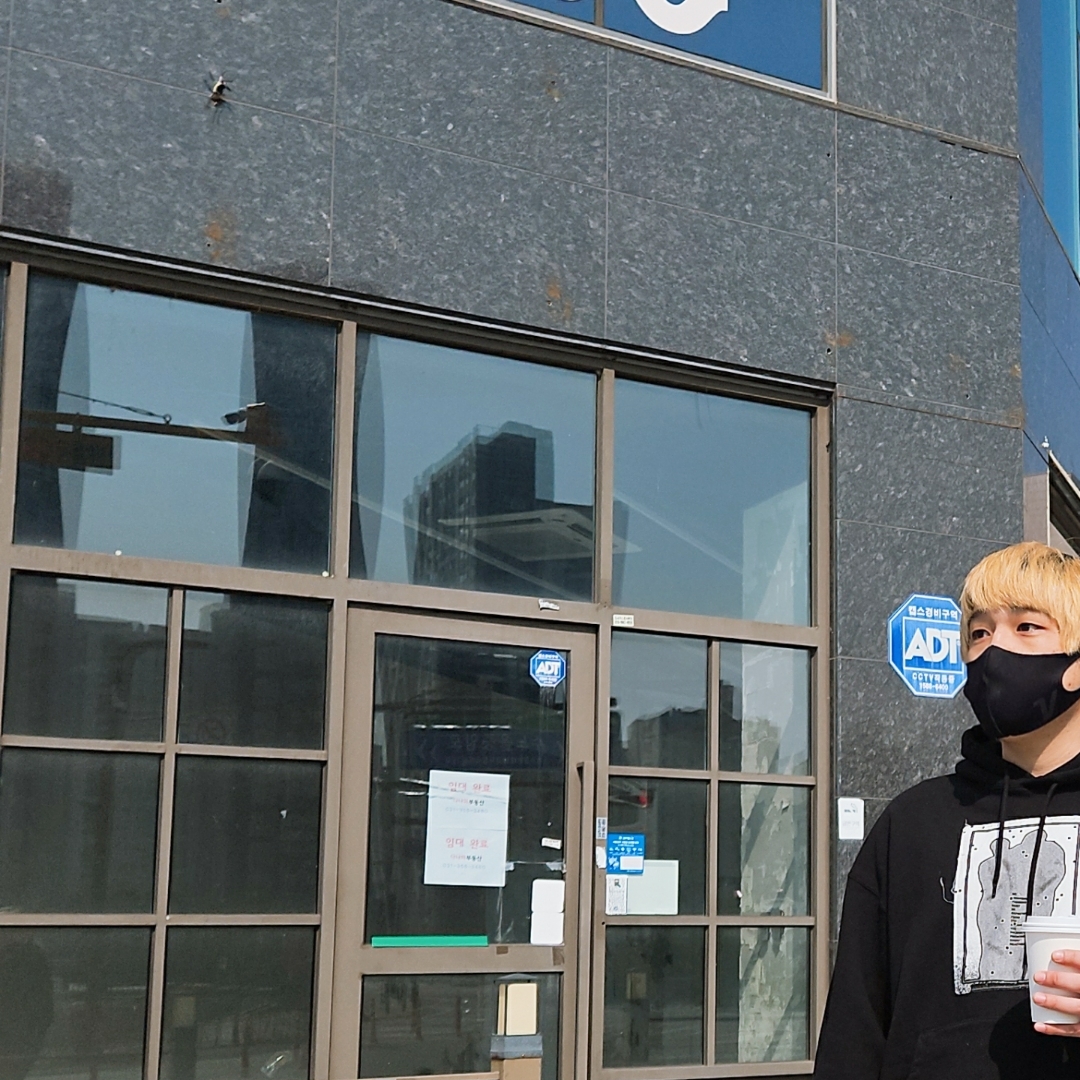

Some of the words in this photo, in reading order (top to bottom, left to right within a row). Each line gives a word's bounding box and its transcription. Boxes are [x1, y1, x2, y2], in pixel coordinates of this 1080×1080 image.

[904, 627, 961, 665] ADT
[535, 660, 561, 676] ADT
[448, 782, 467, 793] 임대
[445, 838, 465, 849] 임대
[470, 839, 489, 850] 완료
